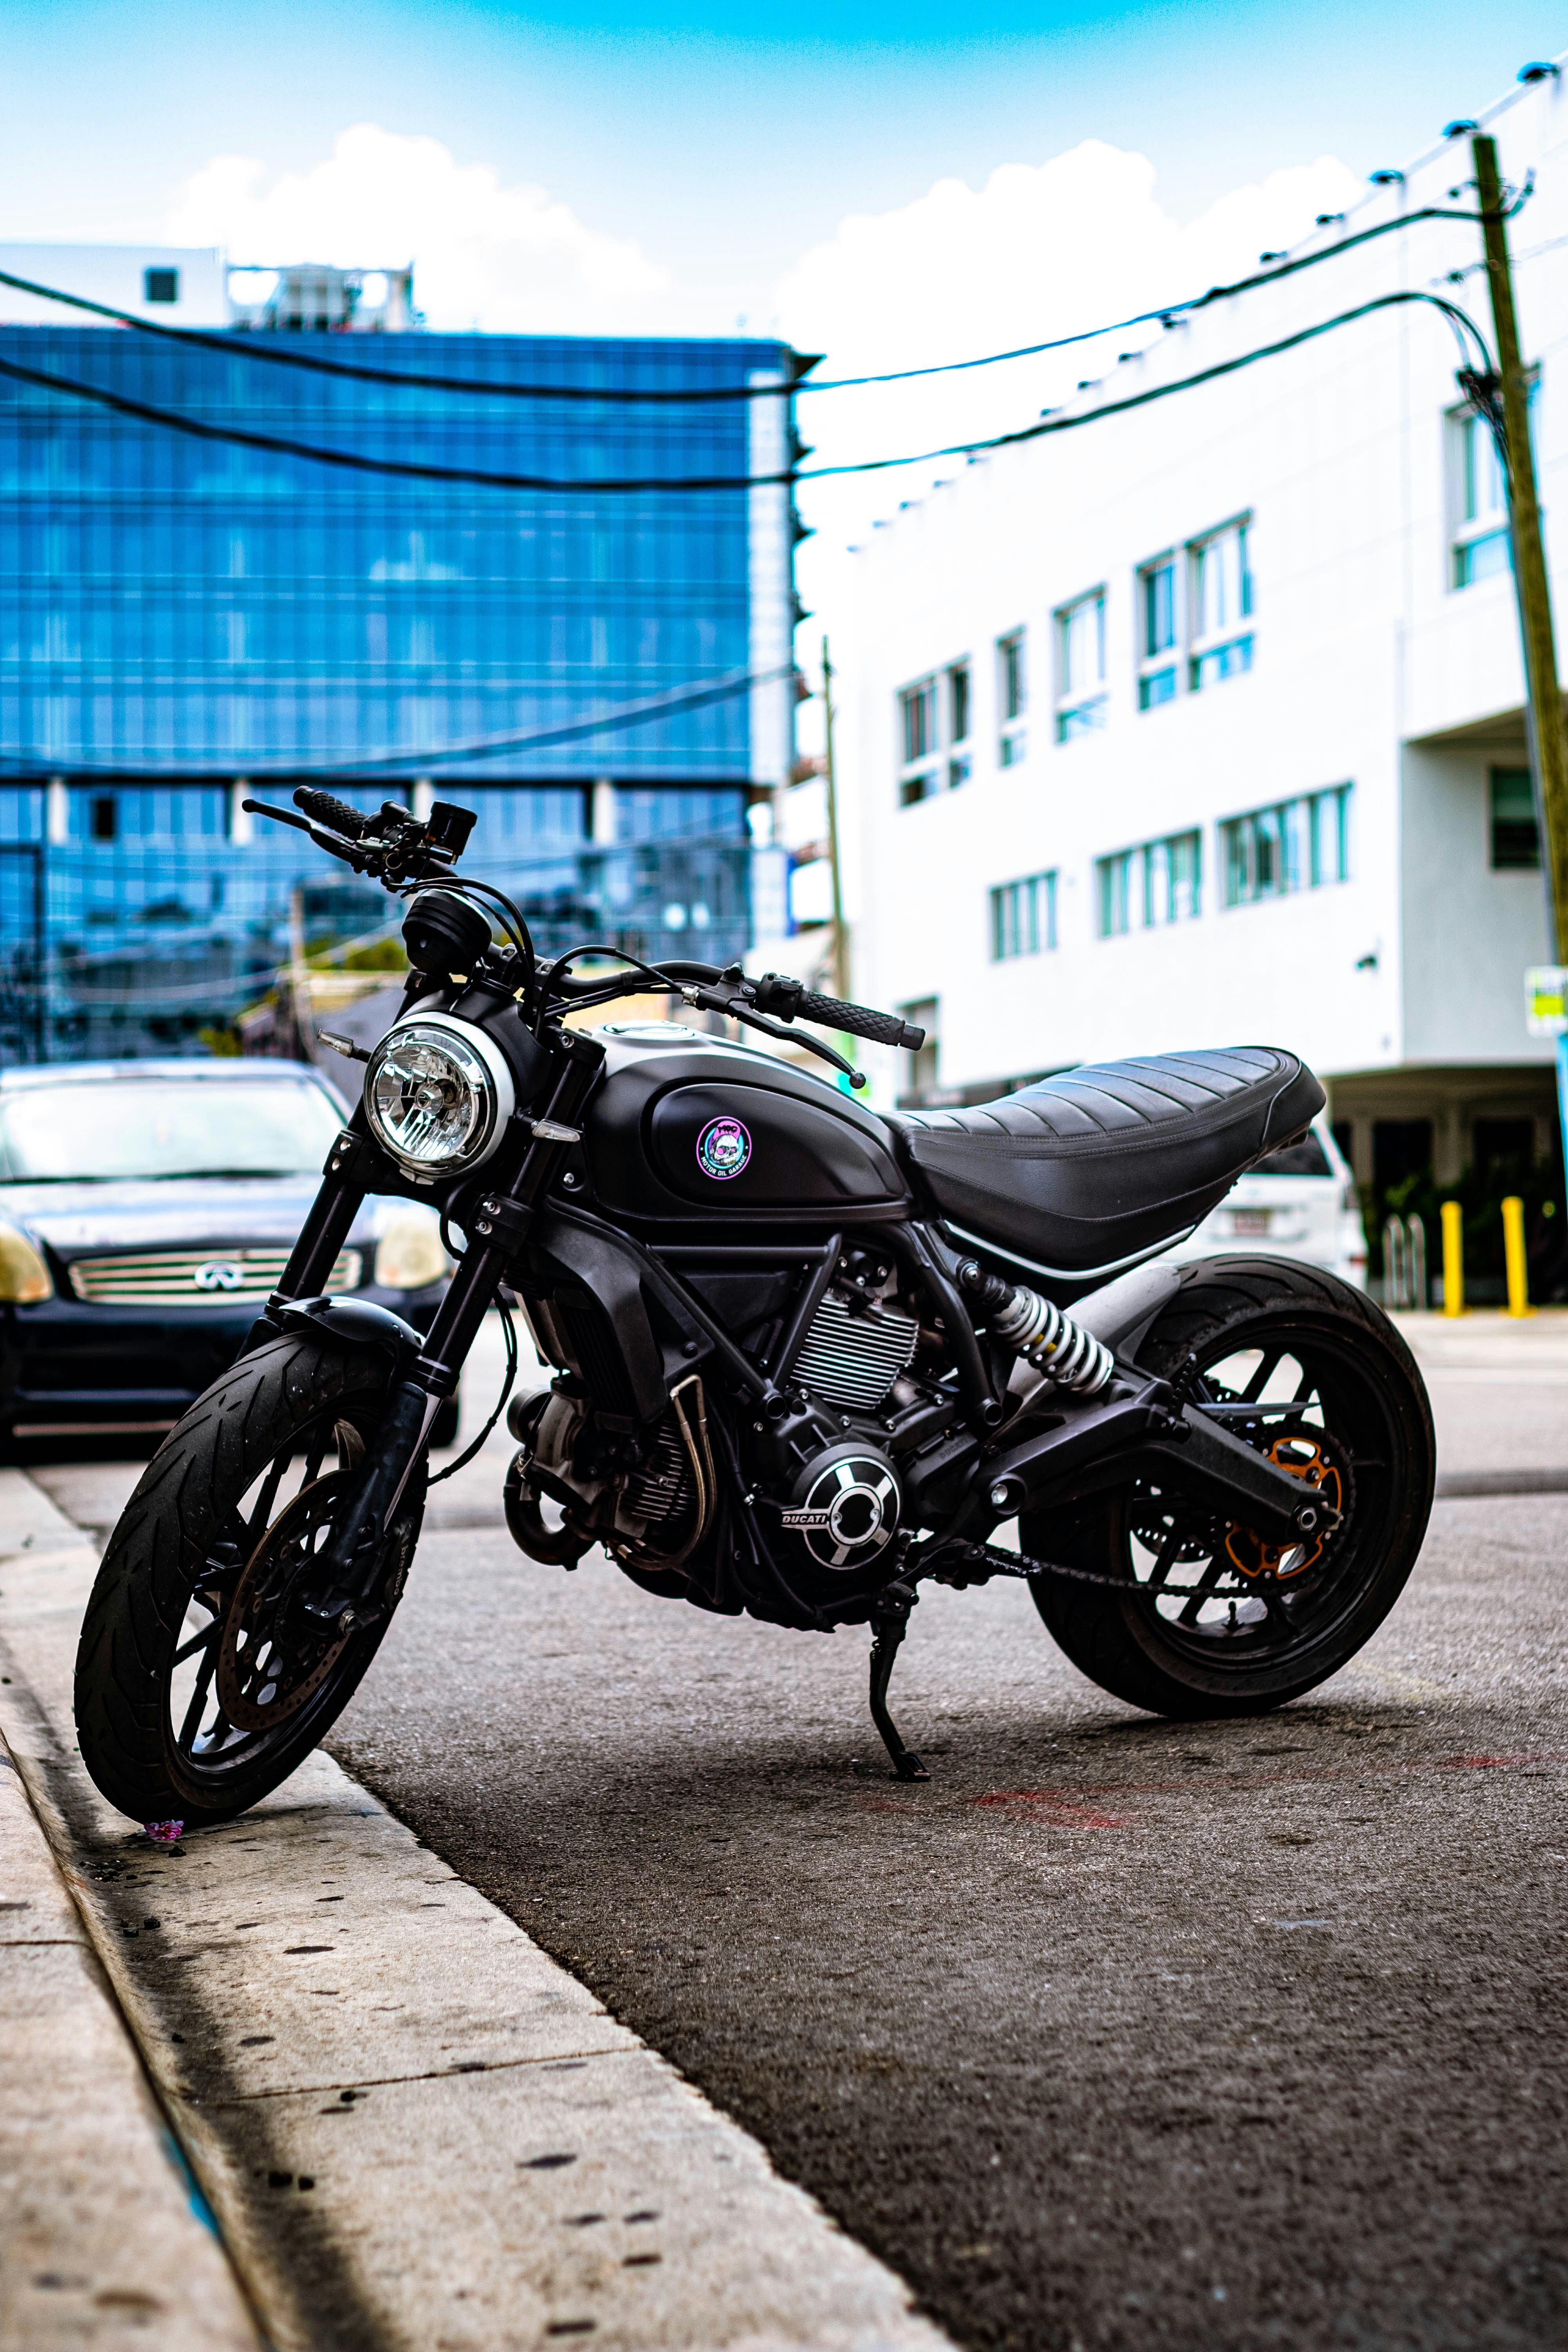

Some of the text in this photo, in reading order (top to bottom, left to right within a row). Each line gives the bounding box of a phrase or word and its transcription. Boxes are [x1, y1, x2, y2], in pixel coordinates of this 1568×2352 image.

[701, 1156, 716, 1174] MOTOR
[728, 1155, 747, 1174] GARAGE
[782, 1515, 826, 1524] DUCATI
[394, 1544, 408, 1595] brembo
